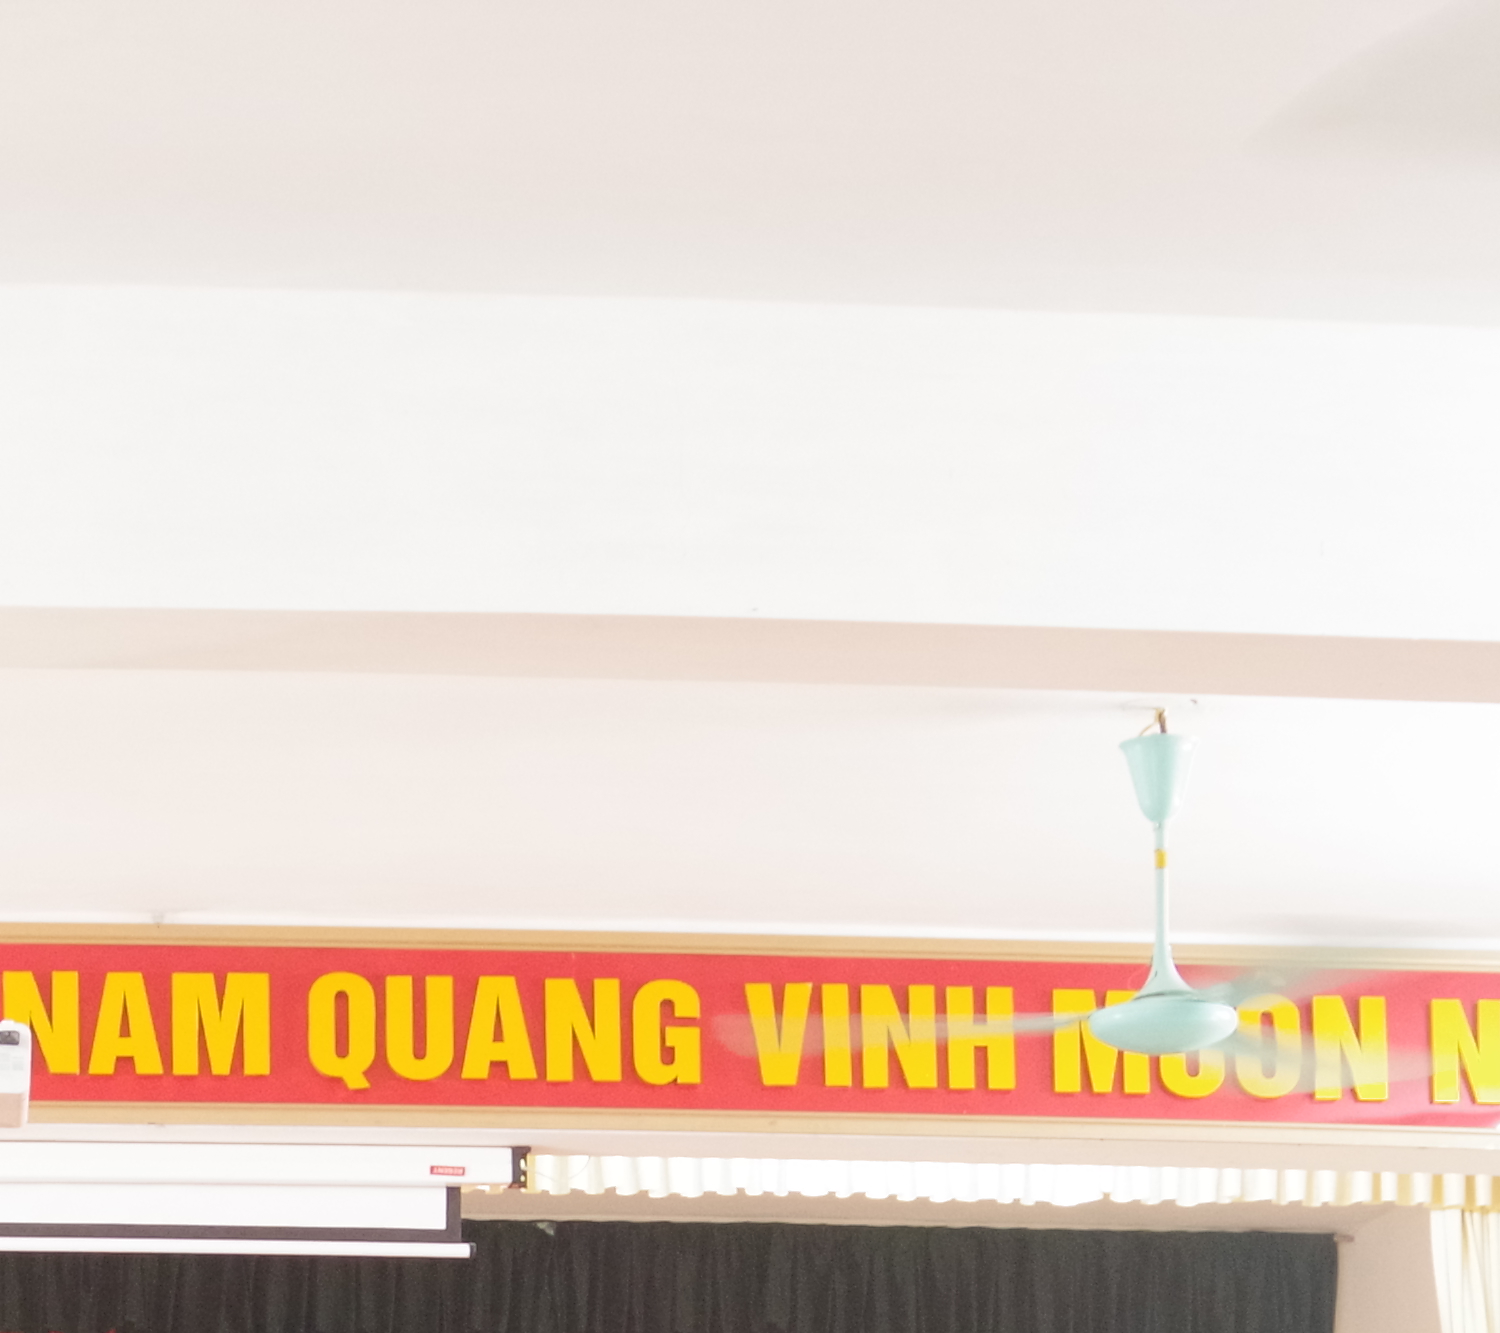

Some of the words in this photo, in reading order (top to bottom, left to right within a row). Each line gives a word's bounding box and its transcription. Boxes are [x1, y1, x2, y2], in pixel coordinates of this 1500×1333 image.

[2, 971, 270, 1075] NAM
[308, 973, 702, 1089] QUANG
[745, 981, 1017, 1090] VINH
